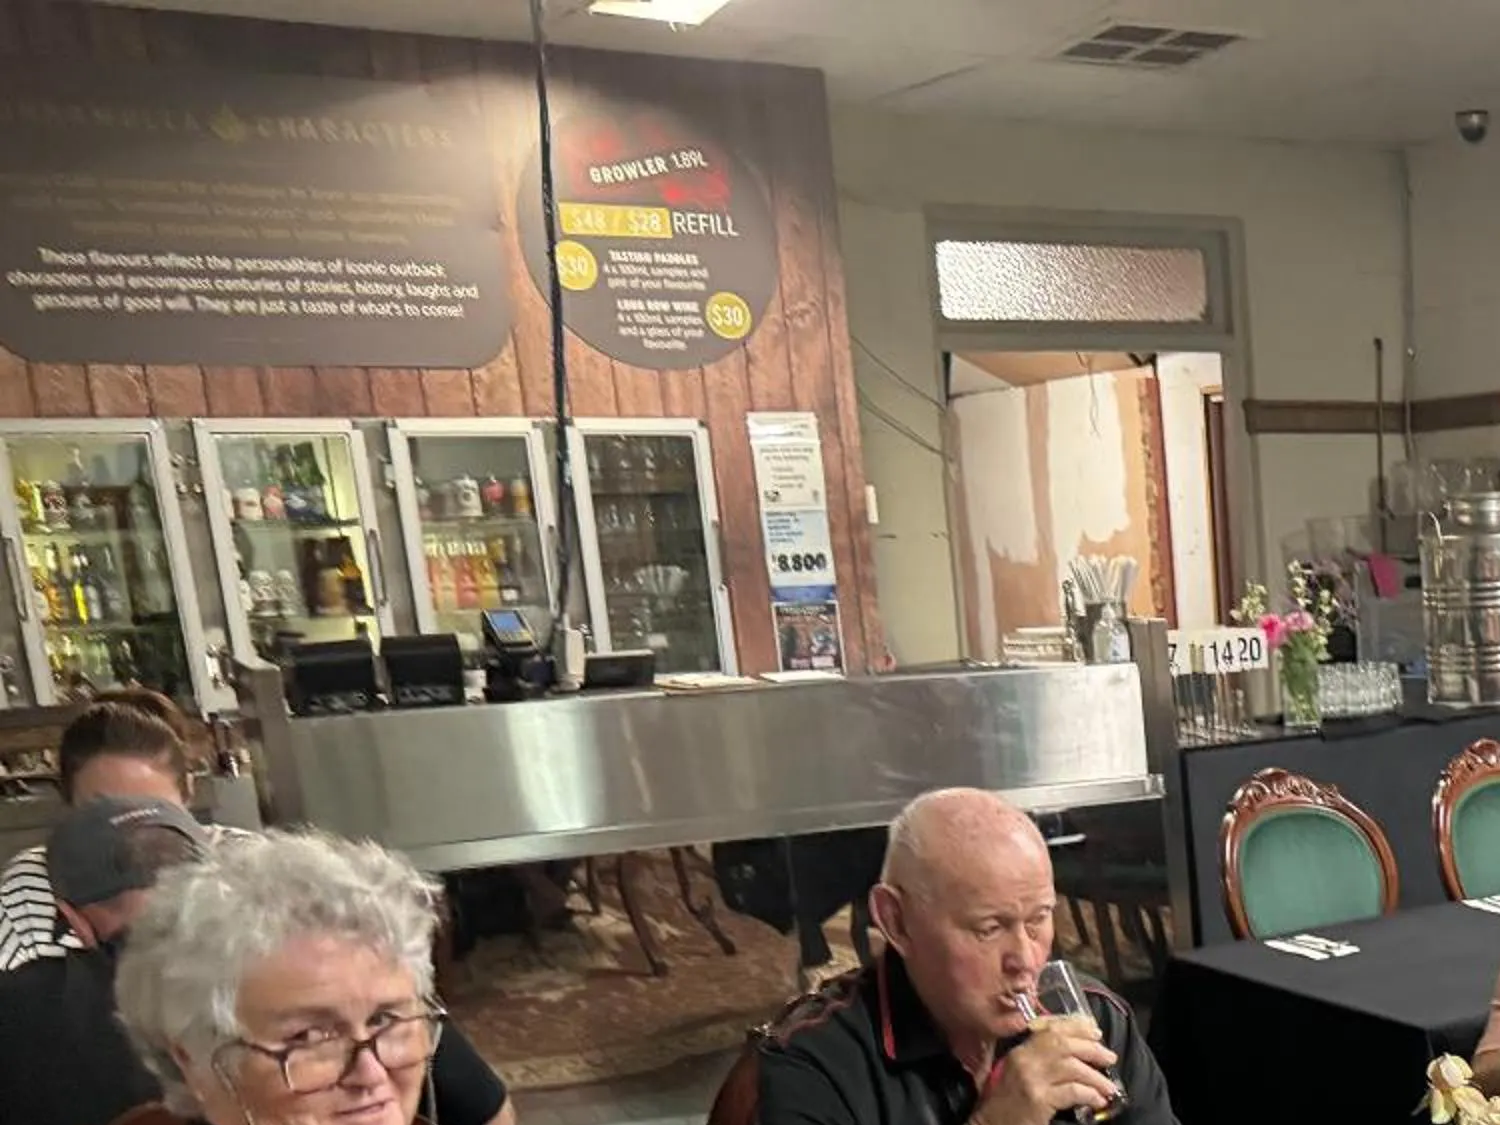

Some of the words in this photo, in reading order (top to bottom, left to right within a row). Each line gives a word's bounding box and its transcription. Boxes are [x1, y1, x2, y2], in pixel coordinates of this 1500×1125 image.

[589, 156, 669, 184] GROWLER
[672, 210, 740, 237] REFILL
[205, 254, 232, 271] the
[233, 256, 326, 275] personalities
[327, 257, 343, 274] of
[344, 257, 388, 276] iconic
[389, 258, 448, 279] outback
[95, 272, 126, 289] and
[214, 277, 284, 293] centuries
[285, 276, 301, 292] of
[404, 281, 451, 301] laughs
[452, 283, 480, 300] and
[103, 293, 121, 310] of
[123, 296, 163, 314] good
[232, 299, 258, 315] are
[259, 299, 287, 316] just
[301, 300, 339, 315] taste
[340, 299, 355, 315] of
[358, 301, 402, 317] what's
[403, 302, 420, 317] to
[421, 303, 465, 319] come!
[711, 304, 744, 327] $30
[1238, 637, 1261, 661] 20
